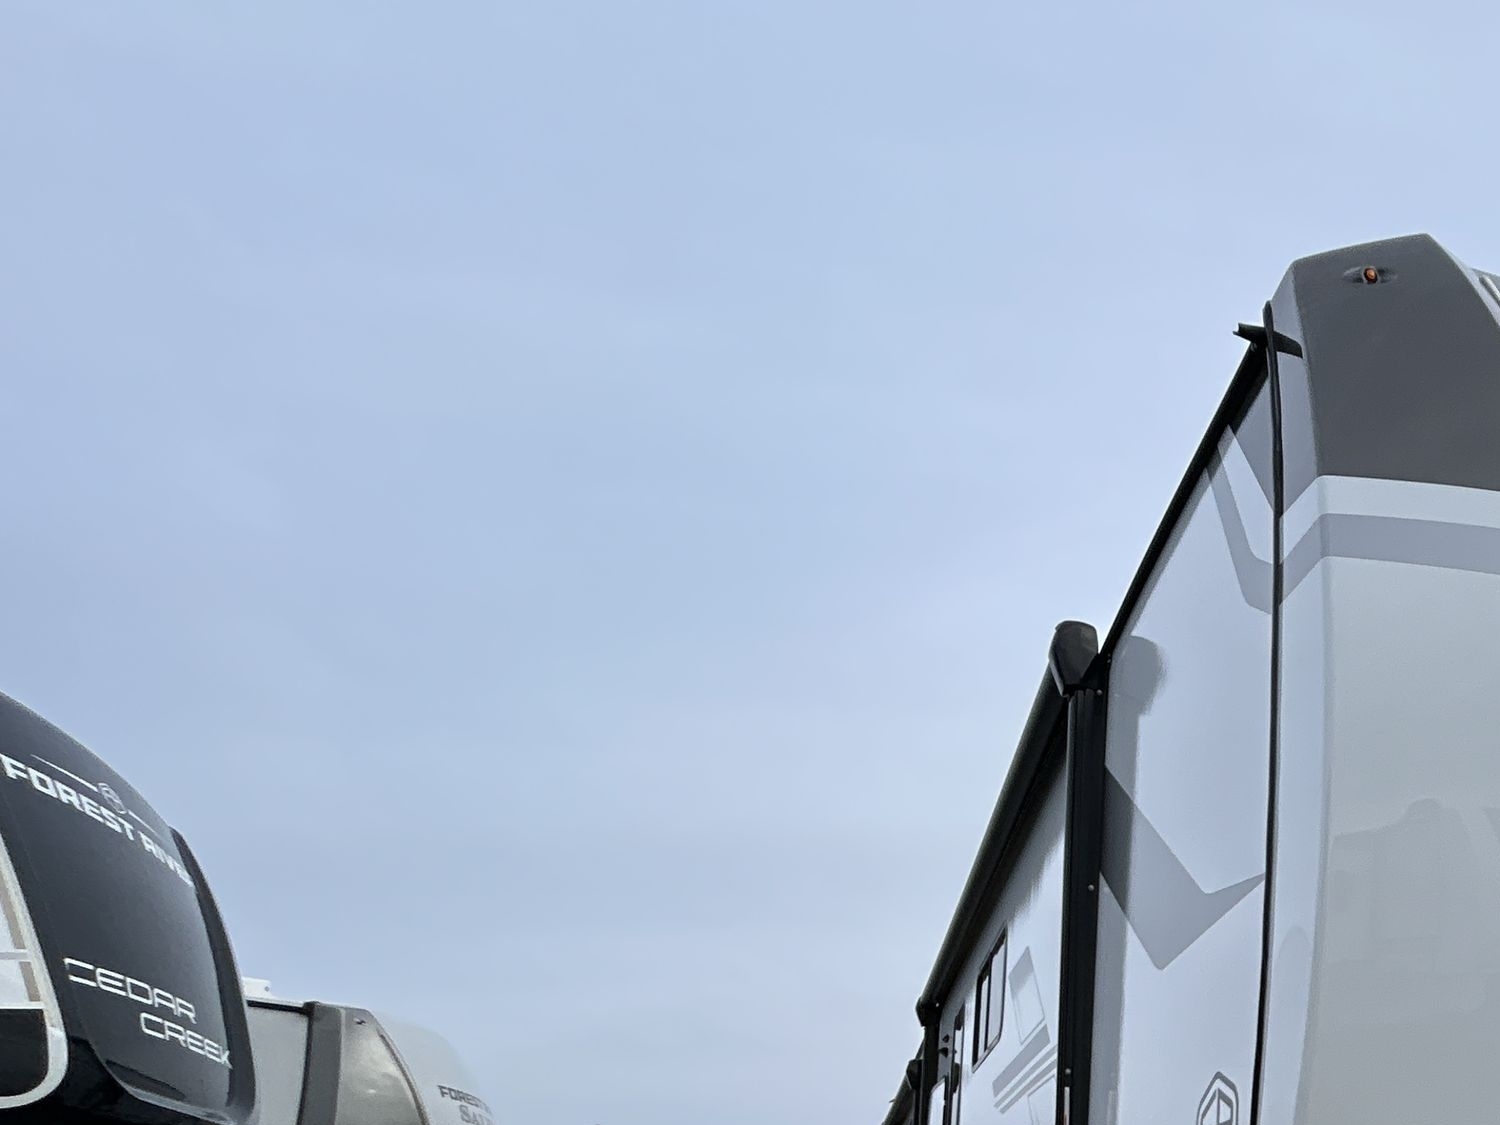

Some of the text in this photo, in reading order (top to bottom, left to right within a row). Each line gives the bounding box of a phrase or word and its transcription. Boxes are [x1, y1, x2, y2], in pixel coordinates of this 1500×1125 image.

[0, 753, 136, 841] FOREST
[63, 957, 198, 1025] CEDAR
[140, 1012, 233, 1070] CREEK
